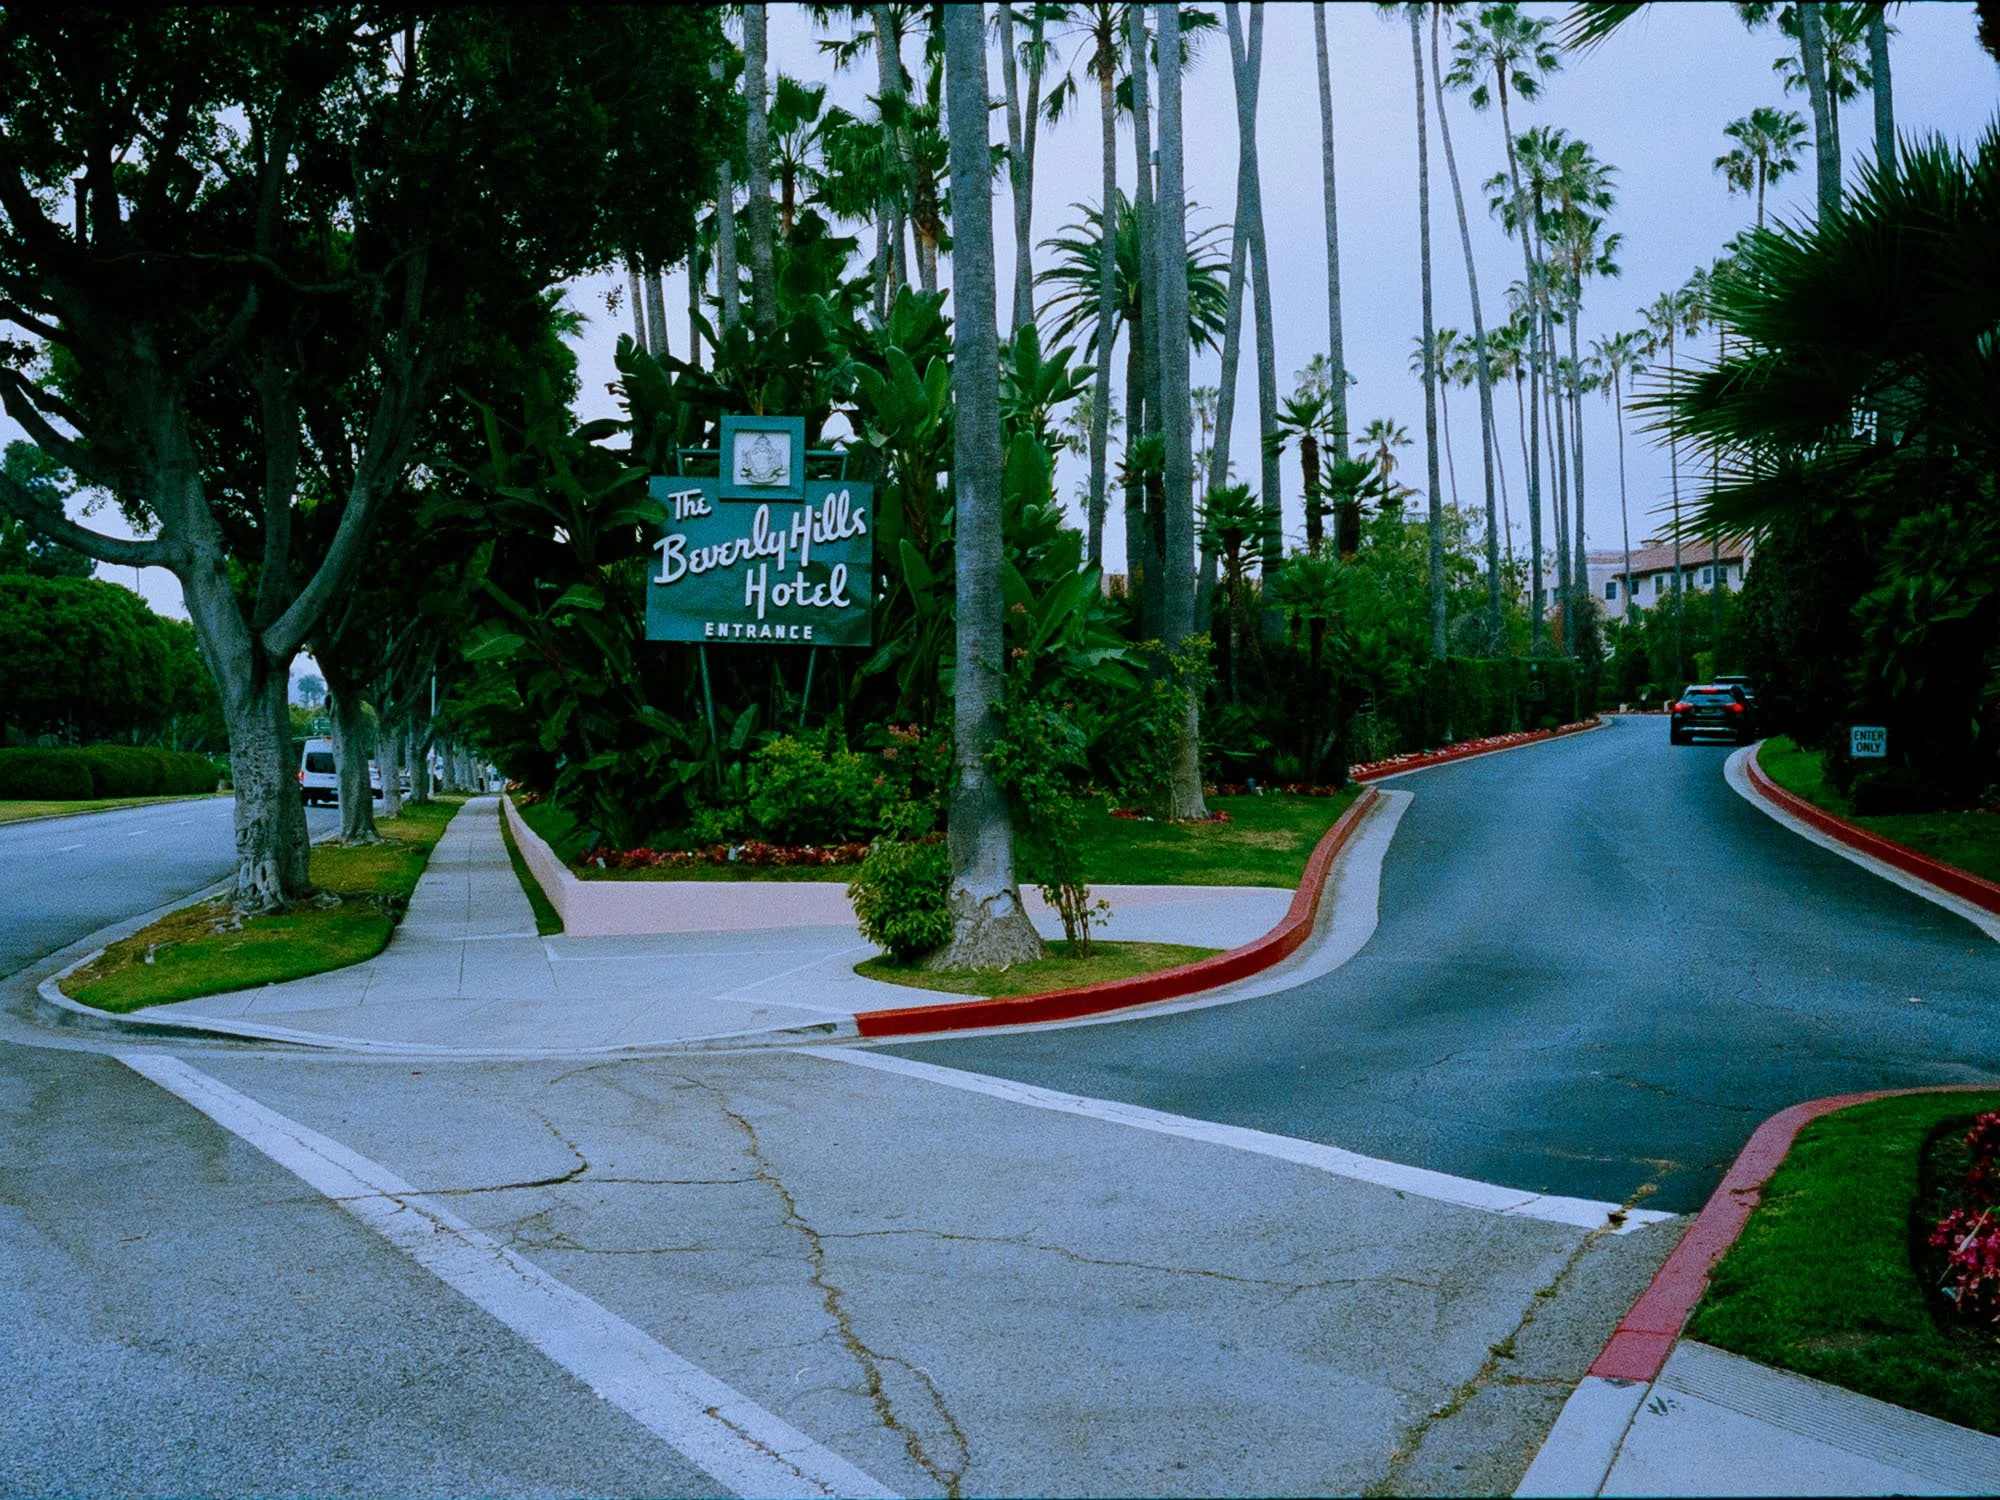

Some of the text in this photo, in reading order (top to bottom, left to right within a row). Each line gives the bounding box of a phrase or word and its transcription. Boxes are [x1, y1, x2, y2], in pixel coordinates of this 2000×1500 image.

[667, 488, 712, 520] The
[653, 489, 867, 584] Beverly Hills
[745, 563, 850, 620] Hotel
[704, 622, 813, 640] ENTRANCE
[1854, 730, 1884, 741] ENTER
[1856, 742, 1881, 753] ONLY
